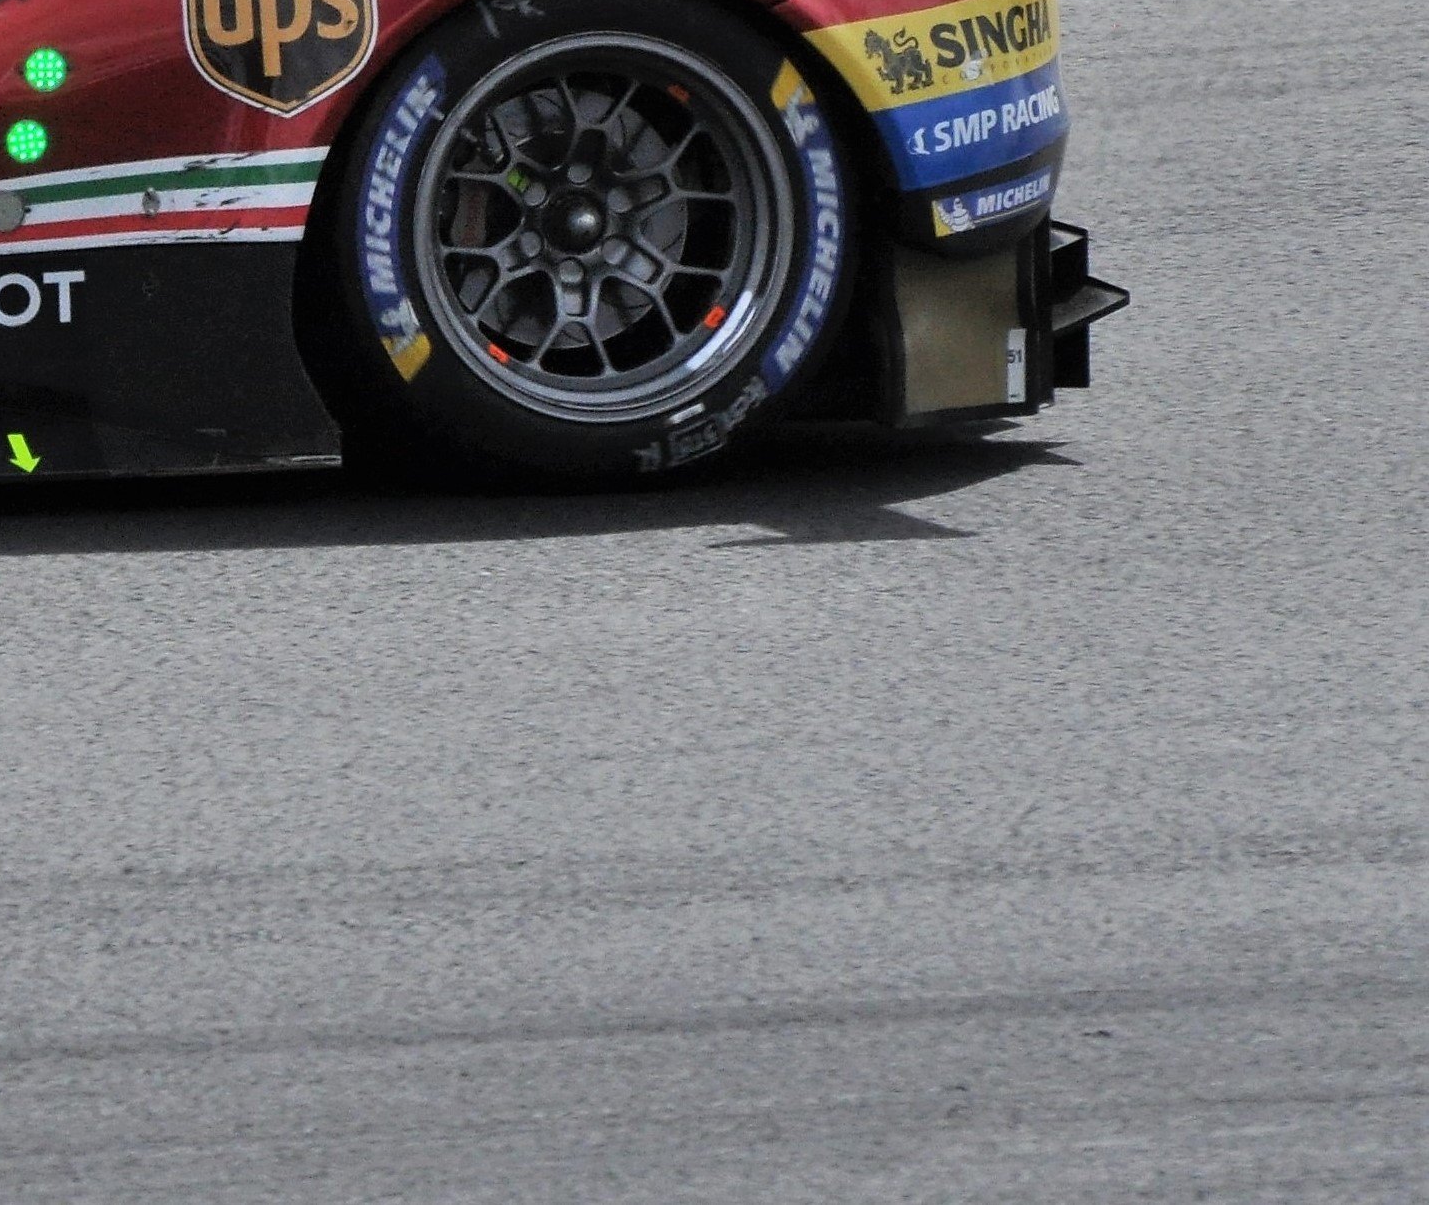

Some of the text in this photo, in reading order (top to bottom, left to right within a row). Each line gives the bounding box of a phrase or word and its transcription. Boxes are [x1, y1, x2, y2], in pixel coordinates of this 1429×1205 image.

[933, 83, 1061, 153] SMP RACING
[363, 74, 437, 297] MICHELIN
[975, 172, 1052, 217] MICHELIN
[773, 148, 841, 374] MICHELIN
[1007, 348, 1023, 365] 51
